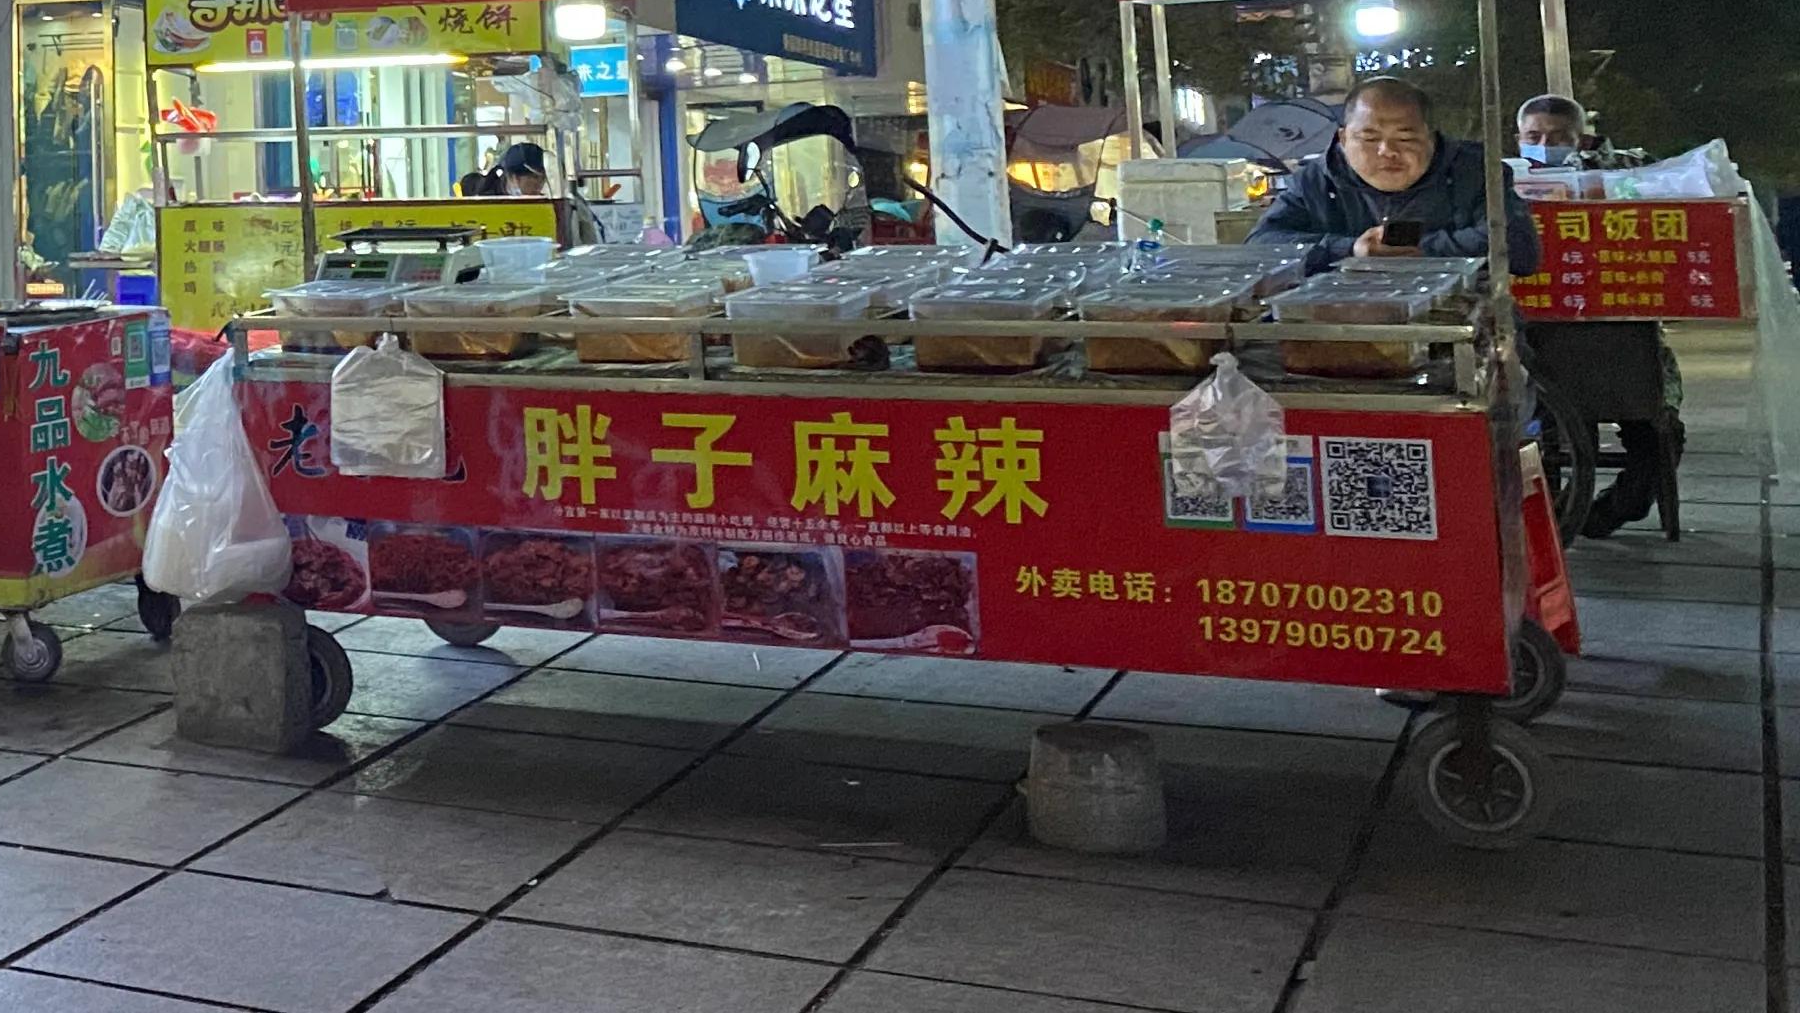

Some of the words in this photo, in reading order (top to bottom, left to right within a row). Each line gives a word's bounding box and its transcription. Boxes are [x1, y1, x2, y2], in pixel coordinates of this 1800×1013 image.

[439, 4, 518, 37] 烧饼
[28, 340, 76, 576] 九品水煮
[521, 404, 1049, 526] 胖子麻辣
[1196, 578, 1444, 618] 18707002310
[1199, 615, 1447, 656] 13979050724
